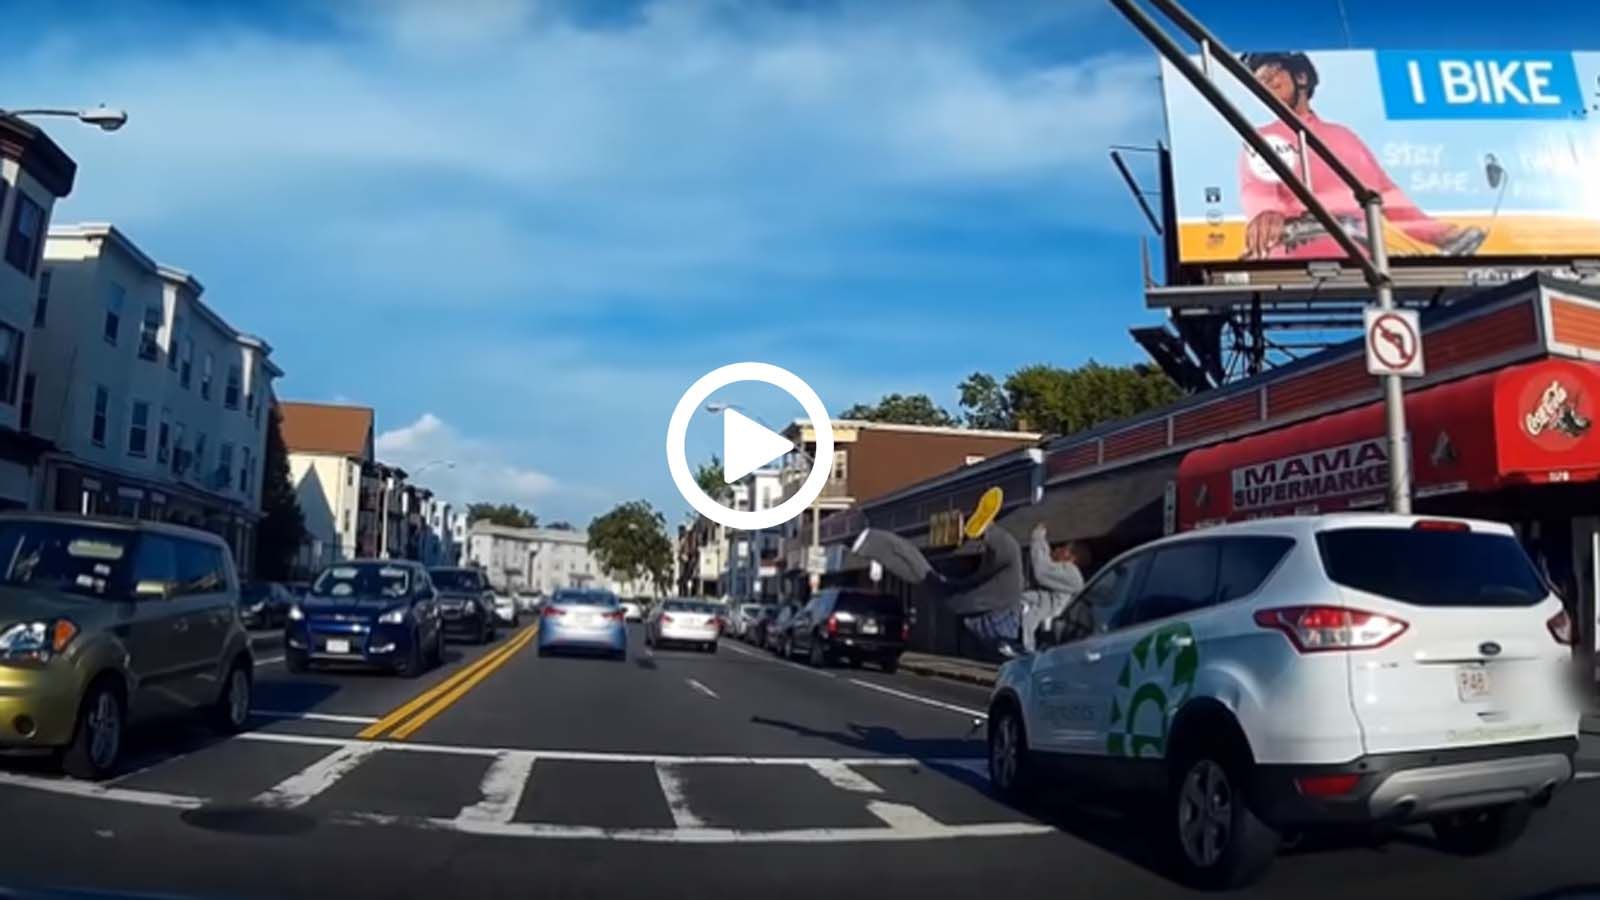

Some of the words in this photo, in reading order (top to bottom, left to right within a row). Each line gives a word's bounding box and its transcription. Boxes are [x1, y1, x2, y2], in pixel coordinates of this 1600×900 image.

[1407, 60, 1426, 104] I
[1438, 60, 1562, 104] BIKE
[1234, 463, 1390, 507] SUPERMARKE
[1244, 443, 1386, 486] MAMA
